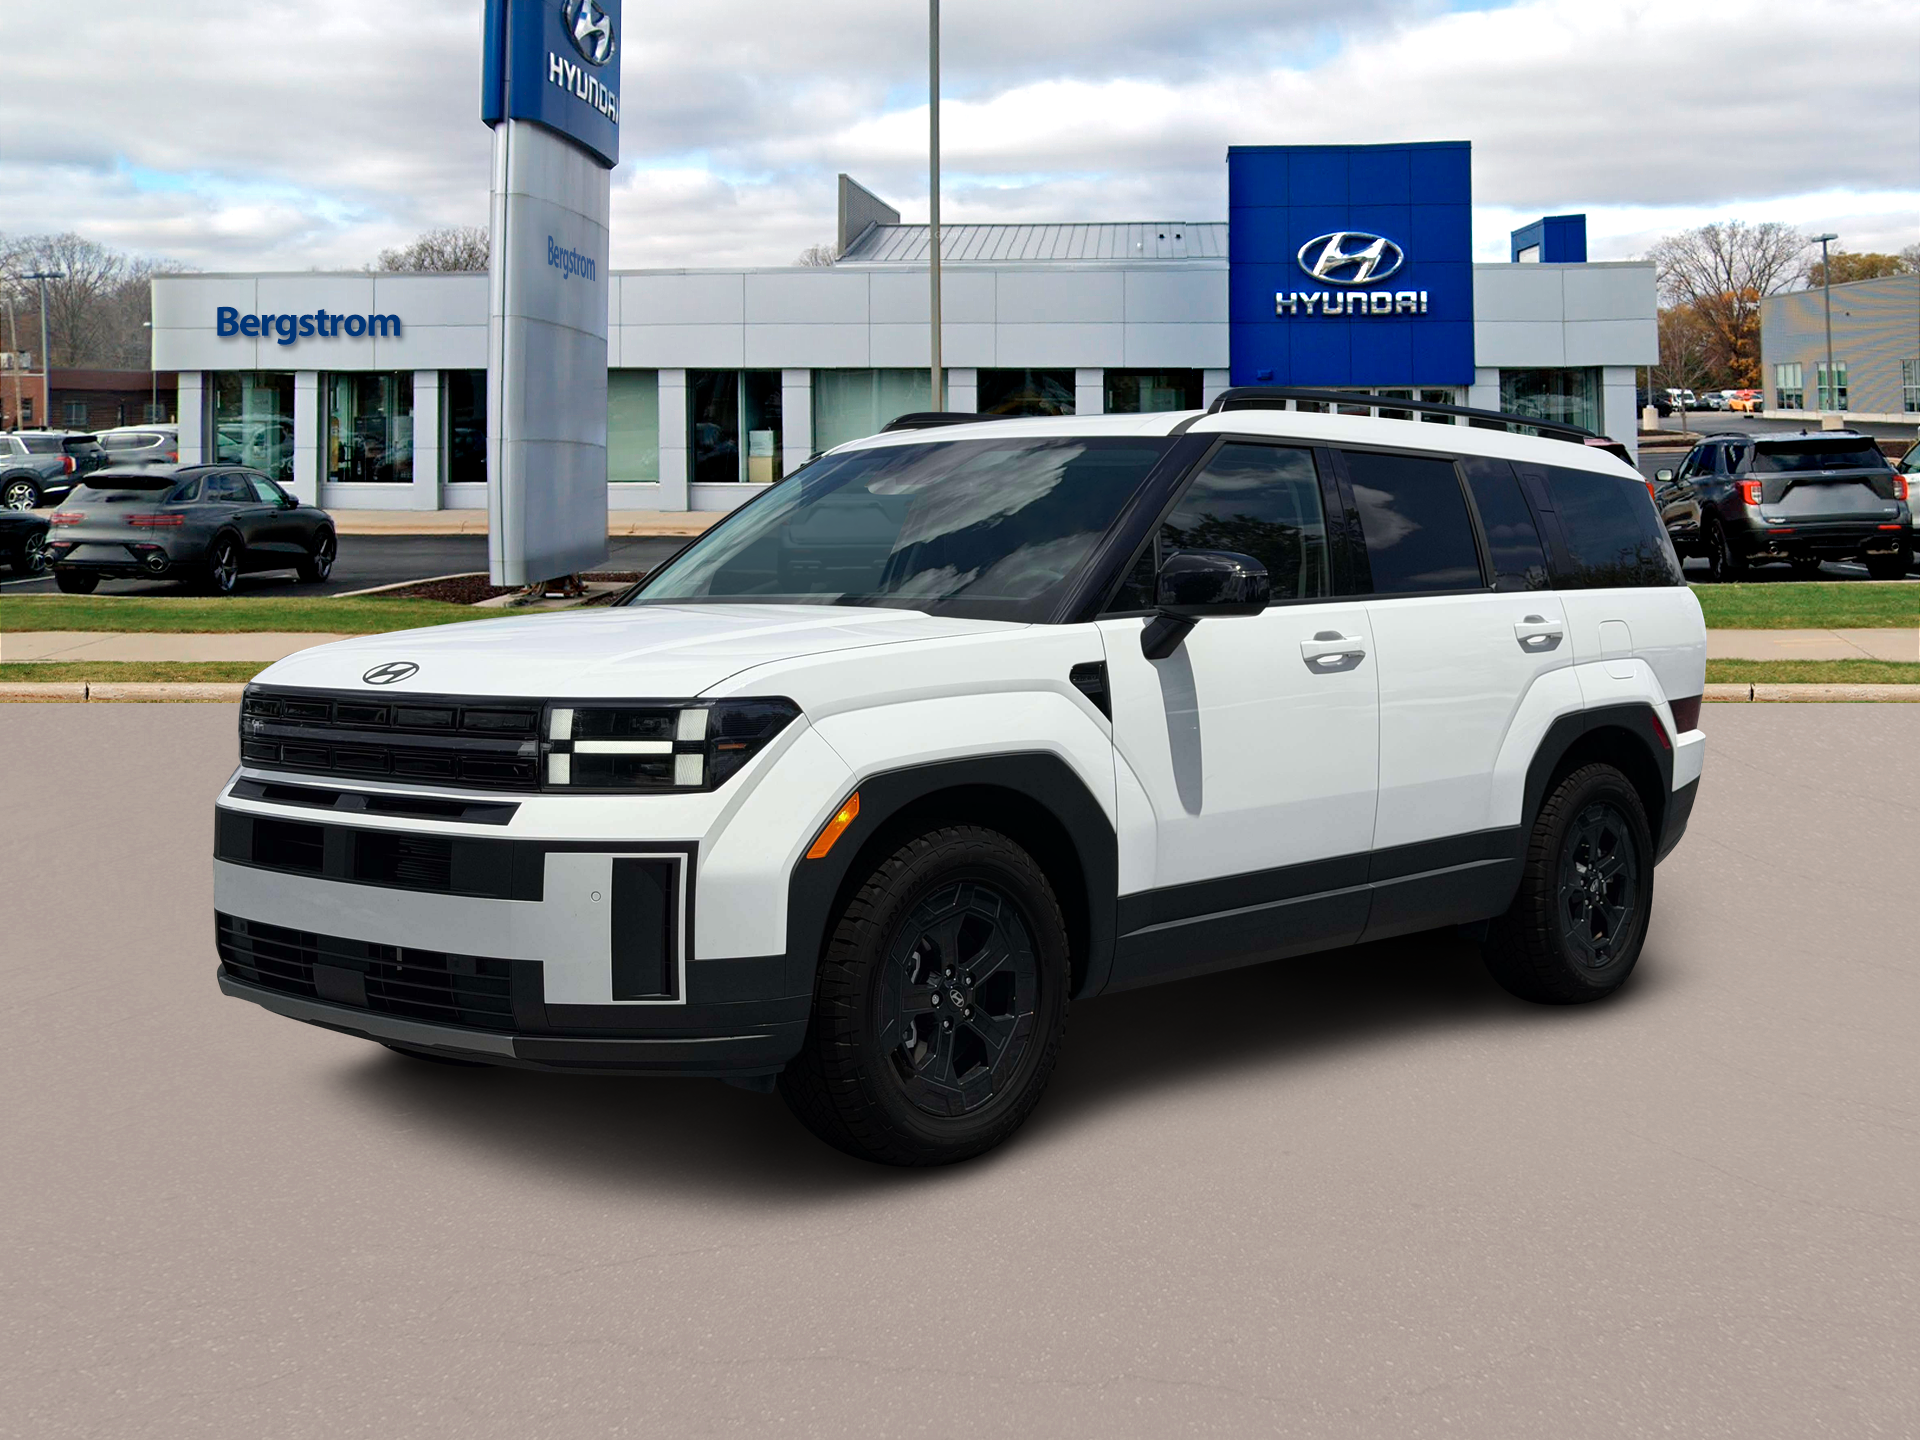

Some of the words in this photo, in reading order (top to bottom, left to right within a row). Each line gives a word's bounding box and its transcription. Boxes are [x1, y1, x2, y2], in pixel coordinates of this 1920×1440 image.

[549, 52, 619, 124] HYUNDAI
[548, 235, 595, 282] Bergstrom
[1275, 291, 1428, 315] HYUNDAI
[216, 306, 401, 346] Bergstrom
